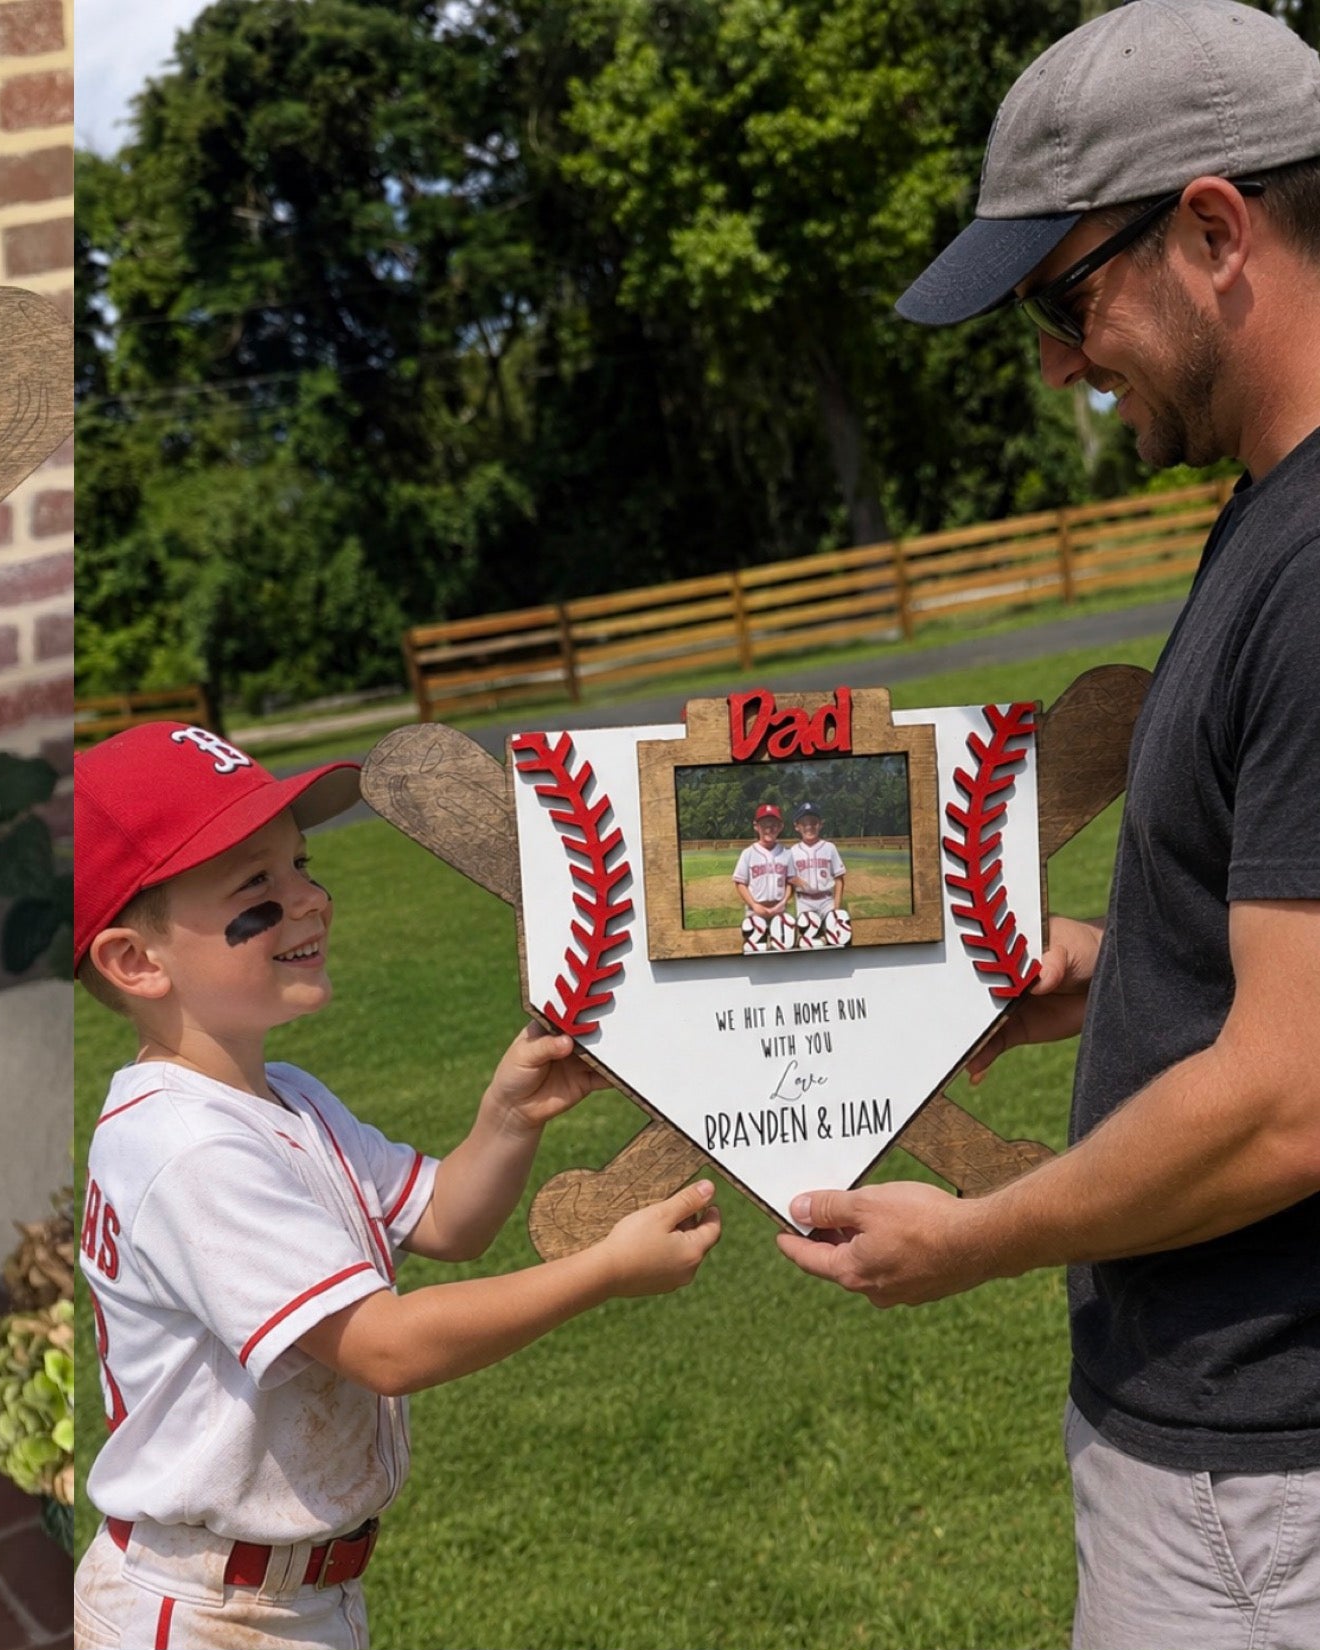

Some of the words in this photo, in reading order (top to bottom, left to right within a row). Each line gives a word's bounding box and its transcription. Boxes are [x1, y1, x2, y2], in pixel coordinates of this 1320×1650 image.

[727, 686, 853, 761] Dad
[741, 908, 853, 953] 2026
[715, 1008, 736, 1032] WE
[743, 1006, 766, 1030] HIT
[775, 1004, 786, 1027] A
[792, 1000, 831, 1026] HOME
[837, 997, 867, 1021] RUN
[761, 1034, 797, 1059] WITH
[805, 1031, 833, 1056] YOU
[770, 1060, 828, 1101] Love
[705, 1104, 808, 1152] BRAYDEN
[817, 1105, 834, 1140] &
[841, 1098, 893, 1139] LIAM
